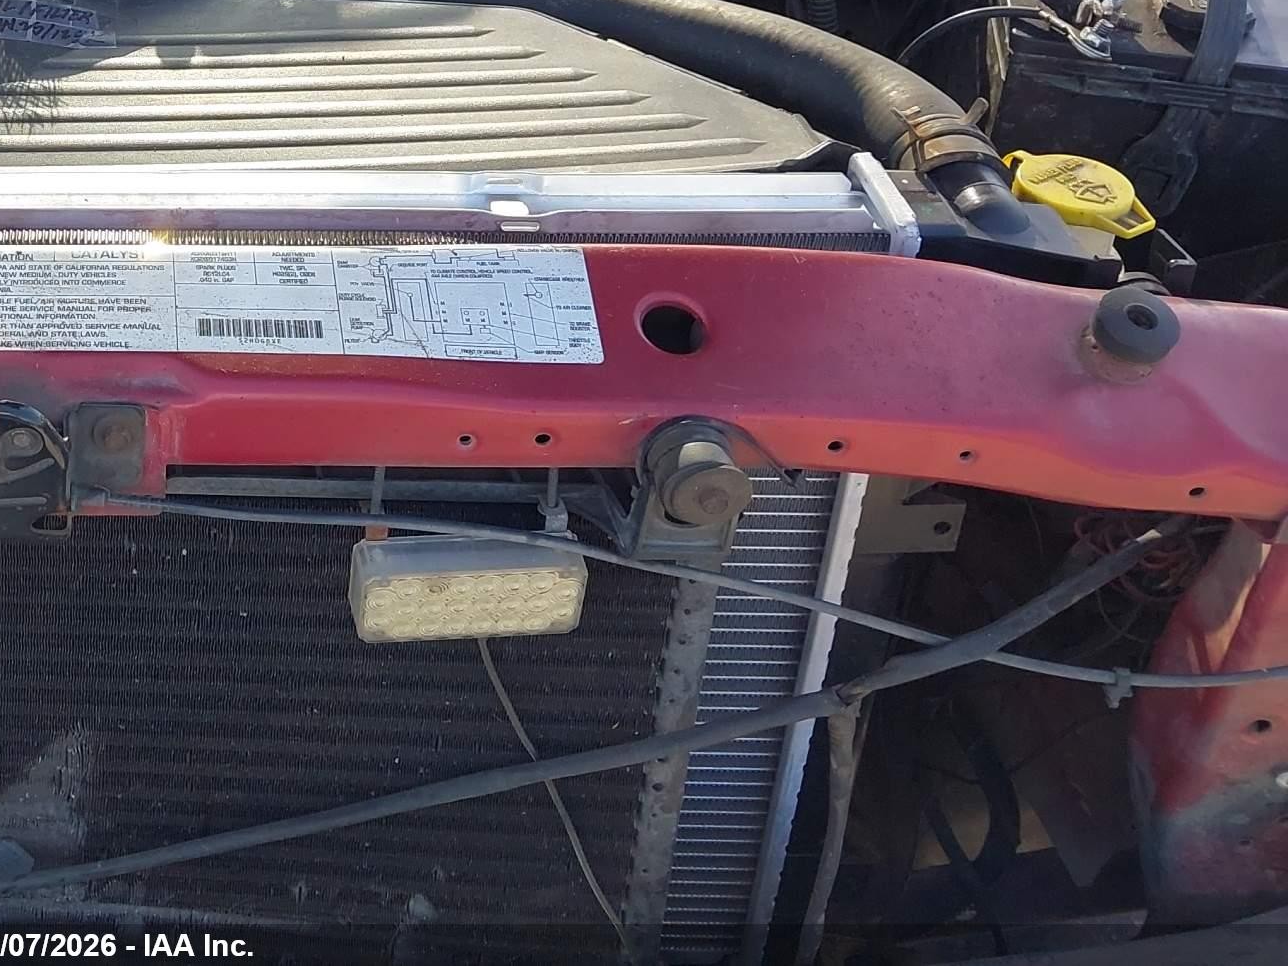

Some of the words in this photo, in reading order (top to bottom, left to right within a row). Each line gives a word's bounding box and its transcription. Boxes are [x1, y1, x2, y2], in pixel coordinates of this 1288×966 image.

[98, 297, 122, 305] HAVE
[123, 297, 147, 305] BEEN
[9, 322, 35, 330] THAN
[36, 322, 83, 330] APPROVED
[84, 322, 121, 330] SERVICE
[122, 322, 162, 330] MANUAL
[27, 330, 49, 338] AND
[50, 330, 78, 338] STATE
[14, 340, 43, 348] WHEN
[43, 340, 92, 348] SERVICING
